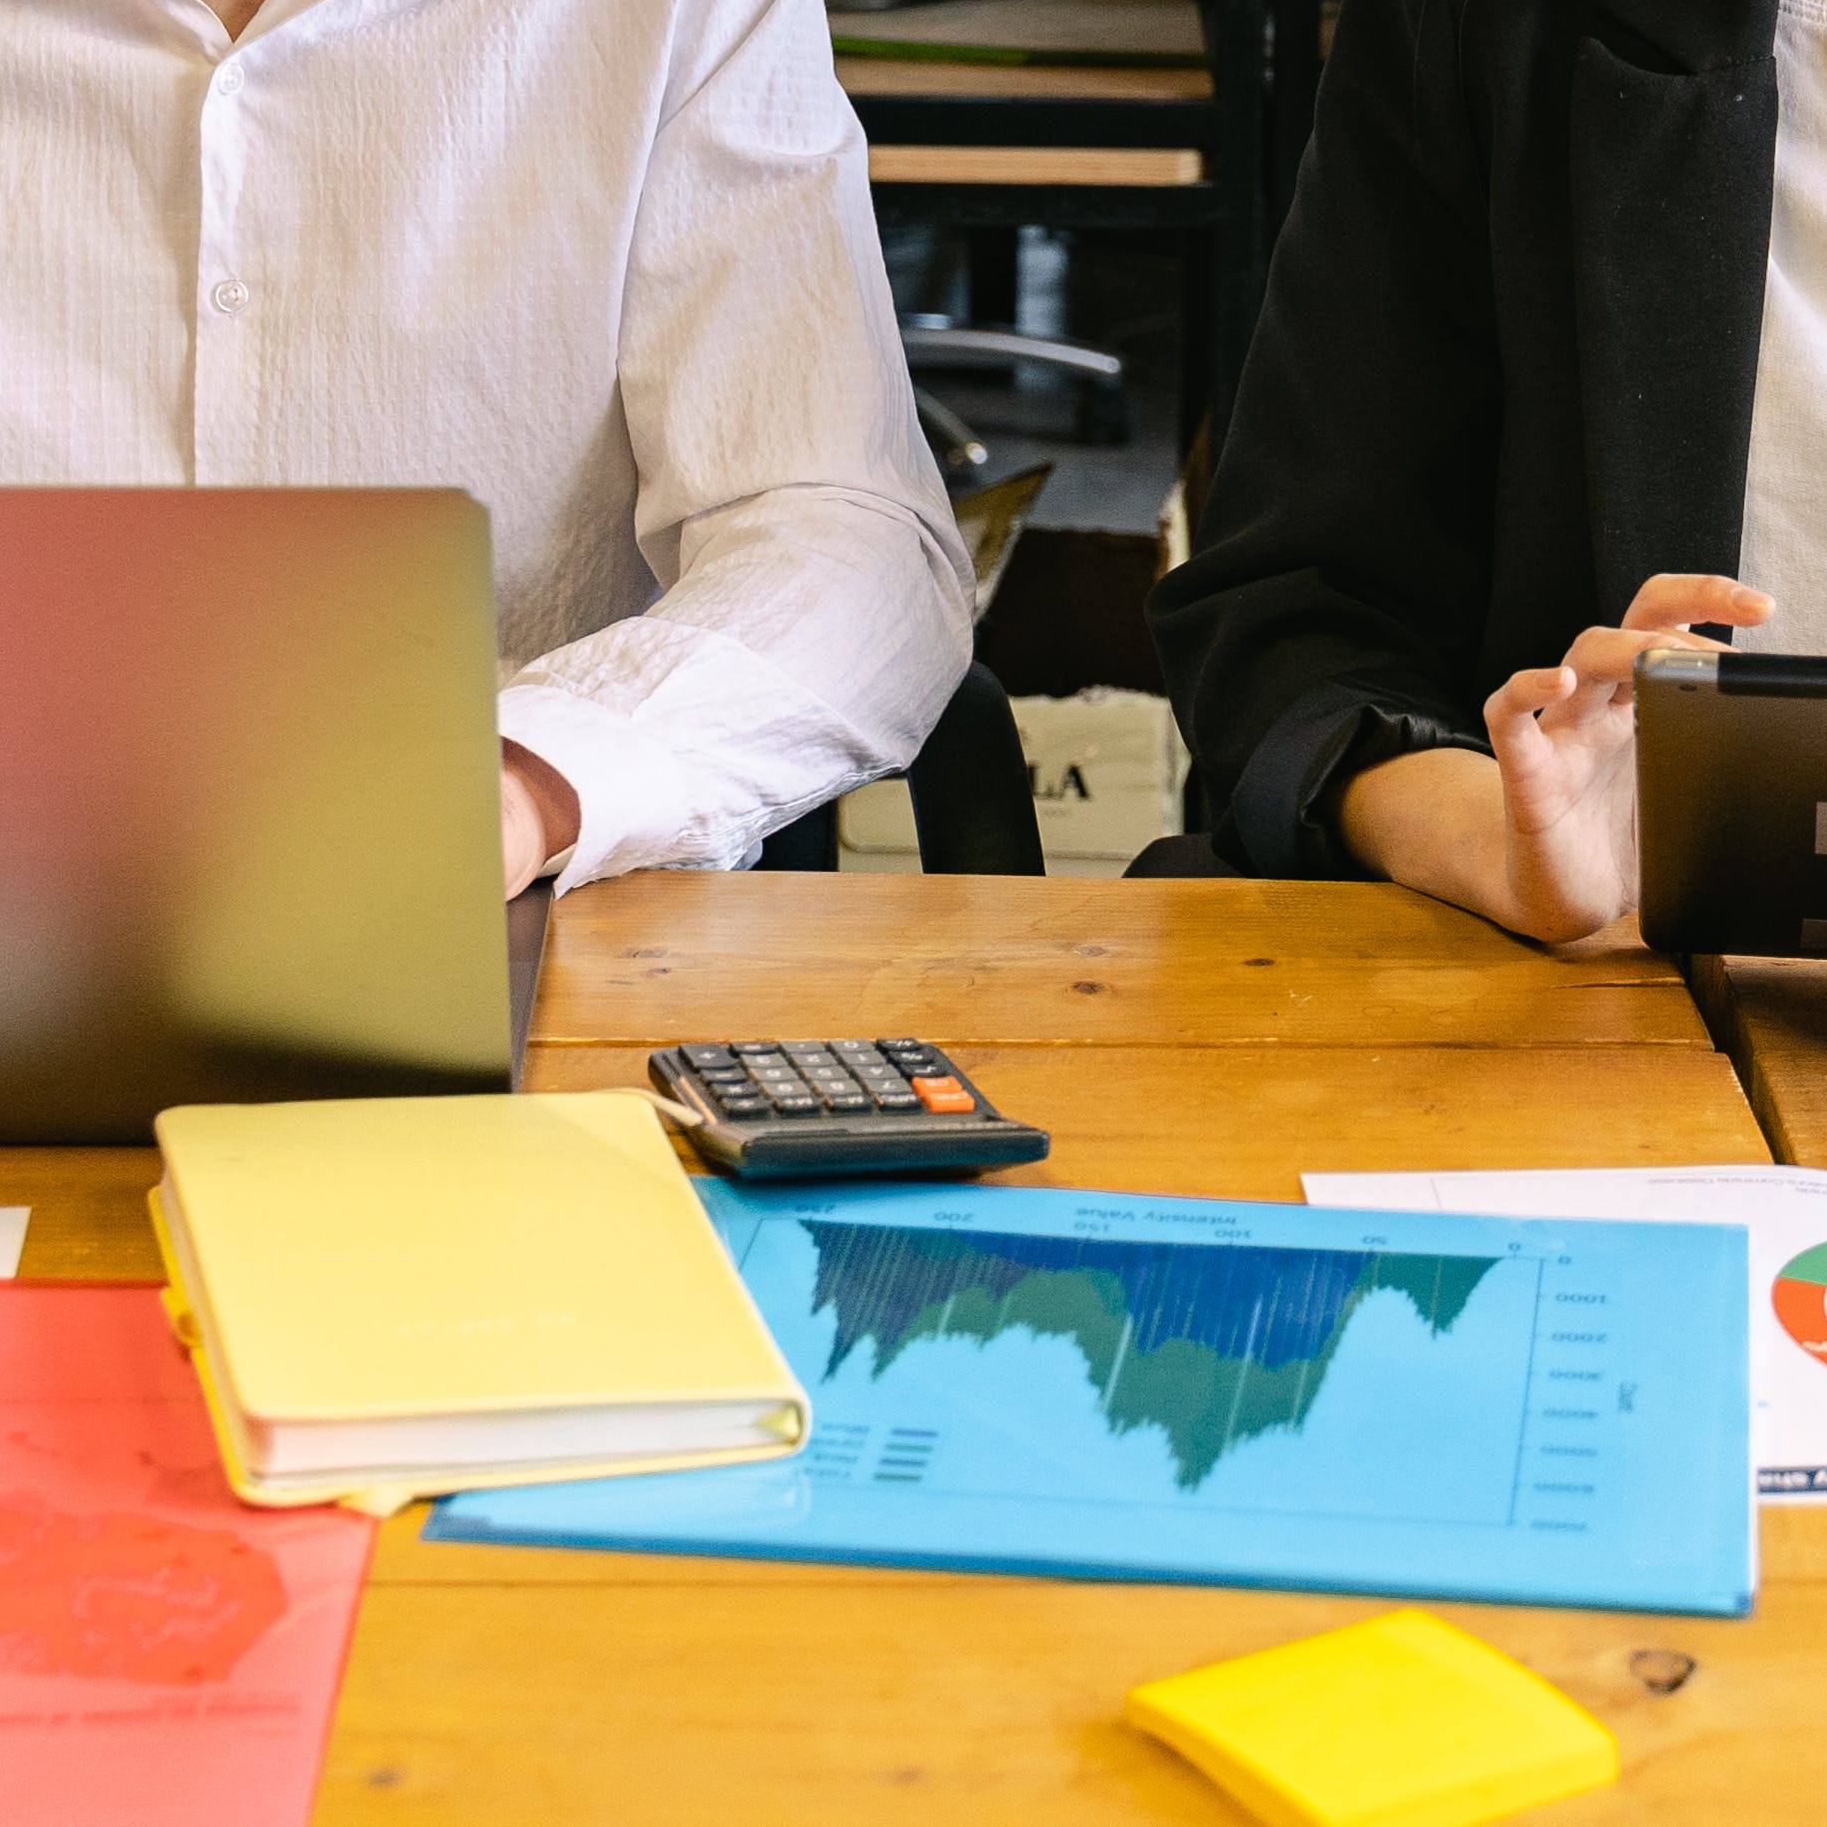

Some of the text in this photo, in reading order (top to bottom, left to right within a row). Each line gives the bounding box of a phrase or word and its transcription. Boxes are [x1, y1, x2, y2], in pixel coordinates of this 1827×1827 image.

[934, 1211, 973, 1222] 200
[1076, 1209, 1236, 1225] Intensity Value
[1215, 1229, 1252, 1239] 100
[1362, 1236, 1387, 1245] 50
[1556, 1293, 1607, 1304] 1000
[1552, 1332, 1607, 1342] 2000
[1758, 1471, 1810, 1490] sha
